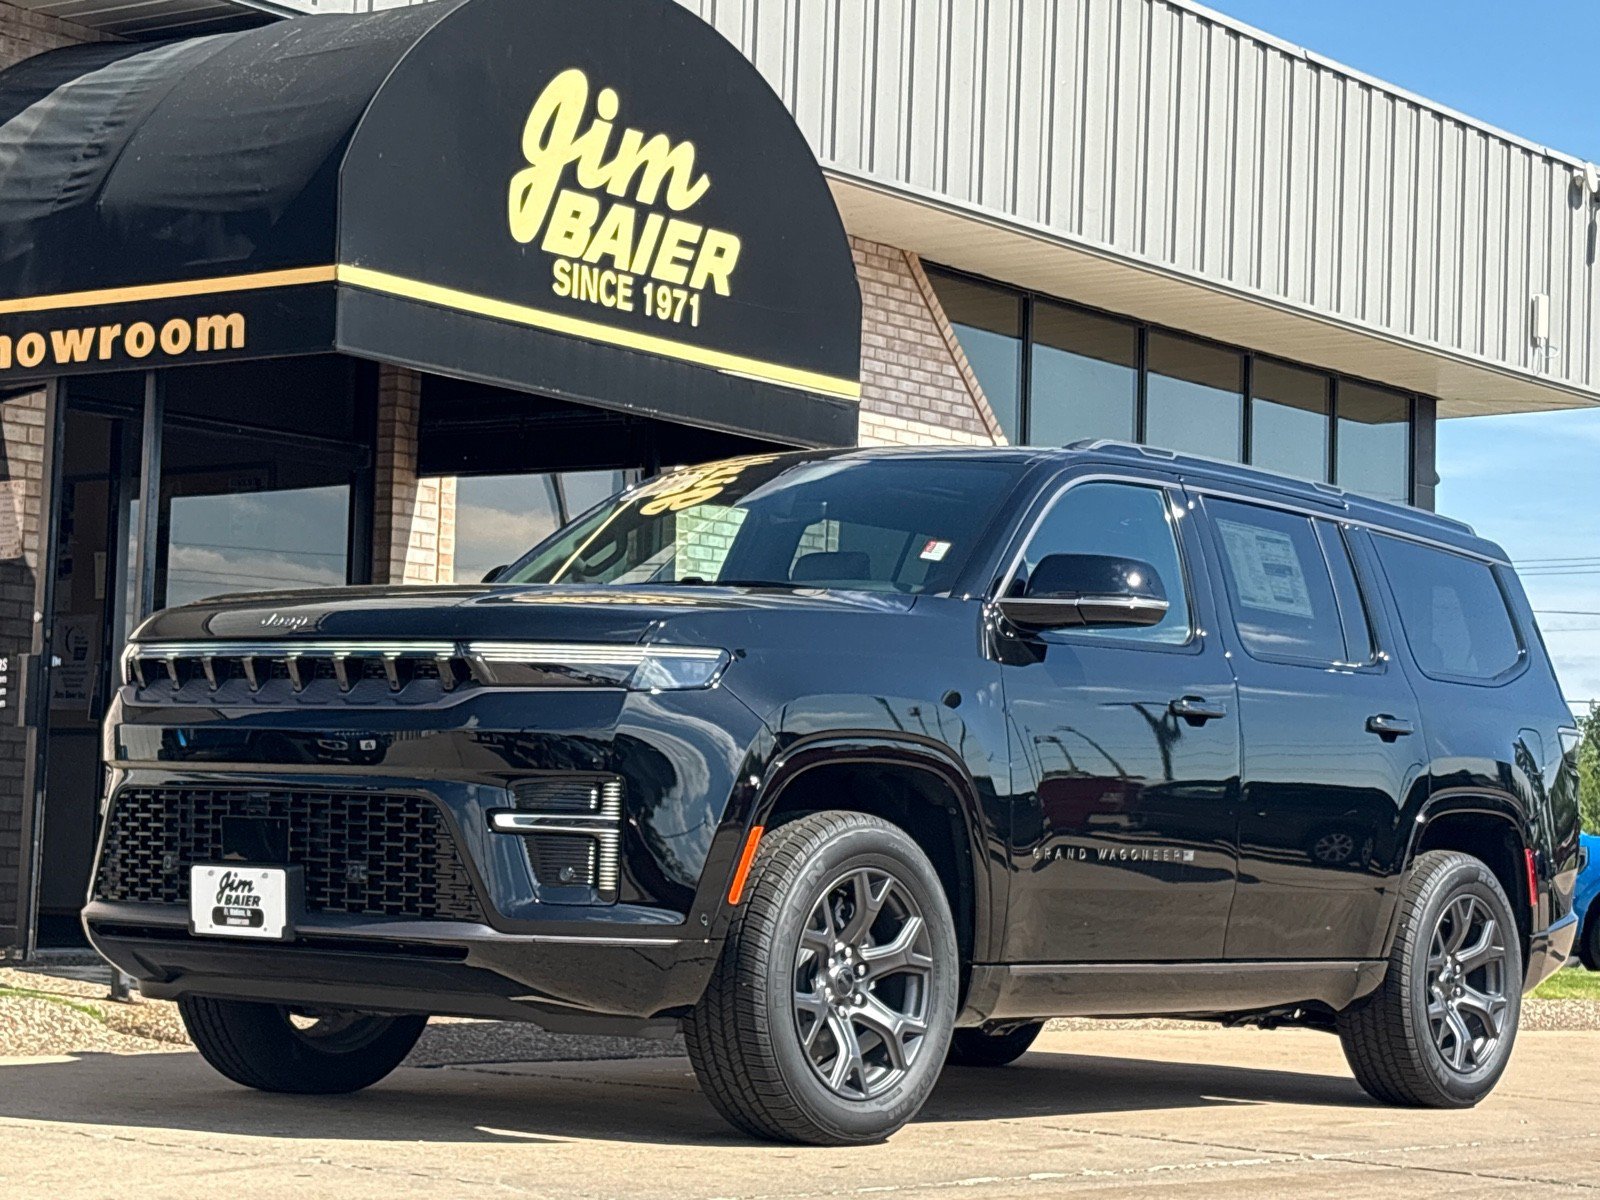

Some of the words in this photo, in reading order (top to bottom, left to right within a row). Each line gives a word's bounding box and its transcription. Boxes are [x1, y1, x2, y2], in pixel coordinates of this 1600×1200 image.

[508, 68, 711, 244] Jim
[541, 189, 741, 297] BAIER
[552, 258, 634, 312] SINCE
[643, 282, 700, 327] 1971
[1032, 847, 1087, 861] GRAND
[216, 871, 254, 904] Jim
[224, 895, 261, 906] BAIER
